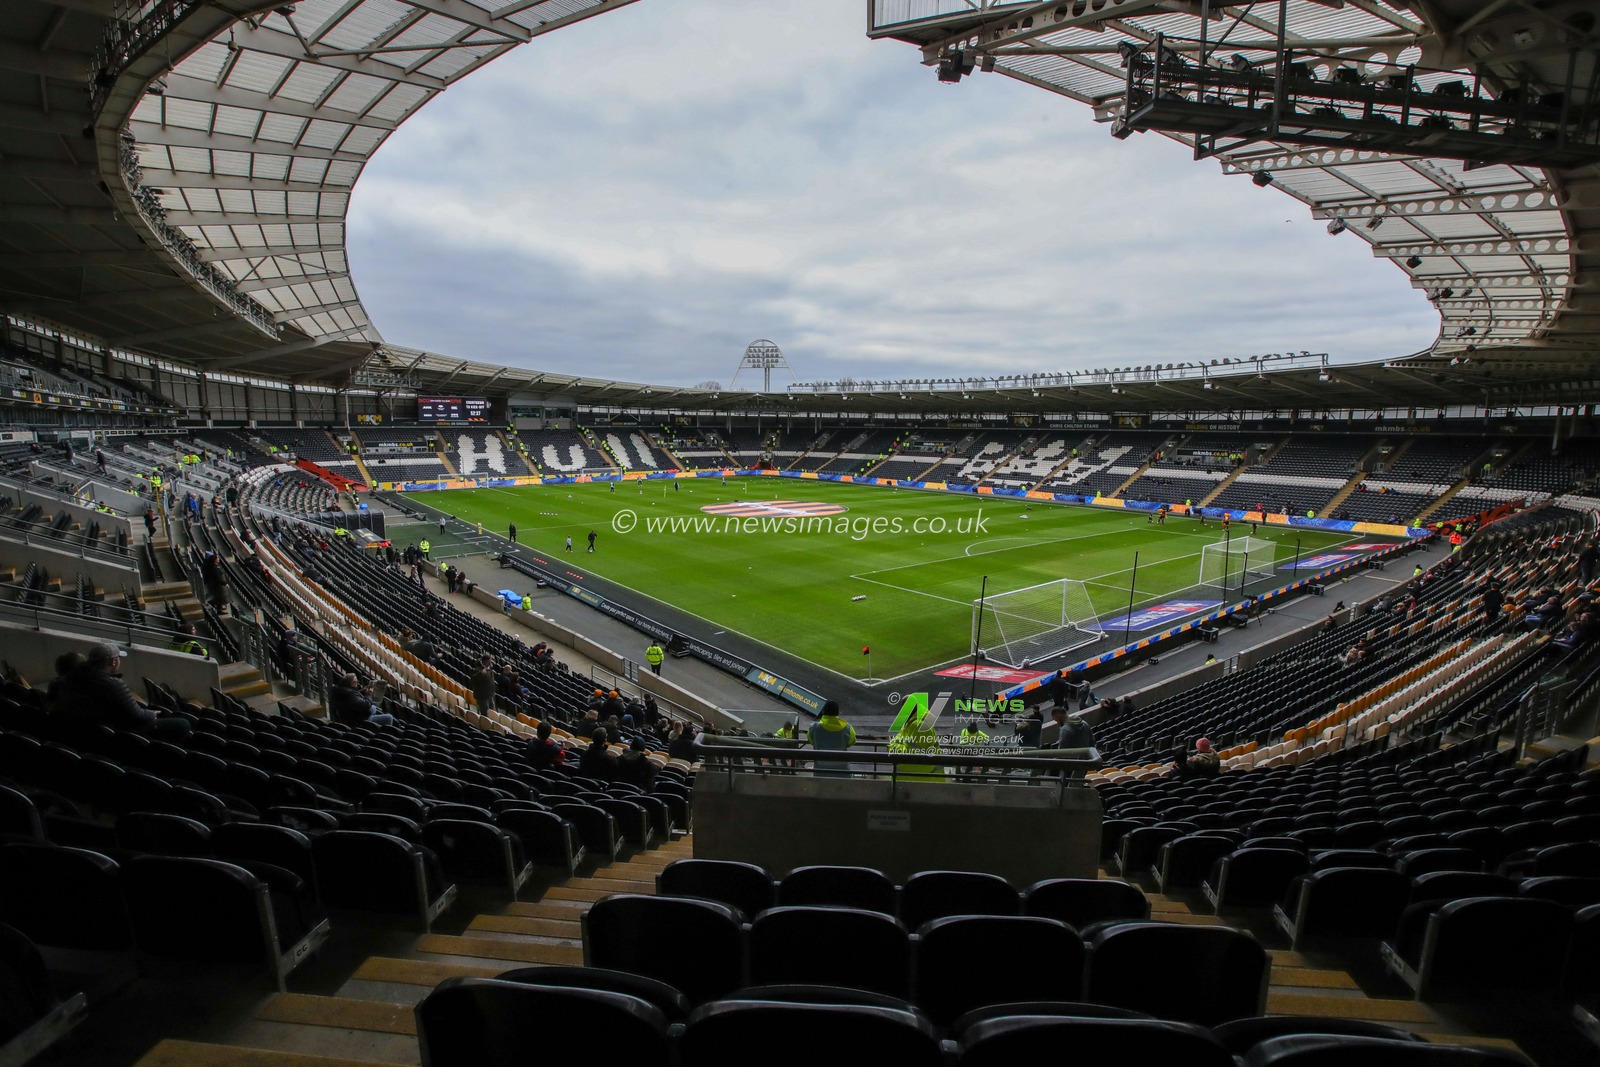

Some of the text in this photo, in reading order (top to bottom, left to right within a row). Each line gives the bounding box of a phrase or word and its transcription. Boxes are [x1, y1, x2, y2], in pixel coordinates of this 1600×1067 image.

[357, 414, 383, 425] MKM
[1118, 416, 1142, 429] MKM
[757, 671, 778, 686] MKM
